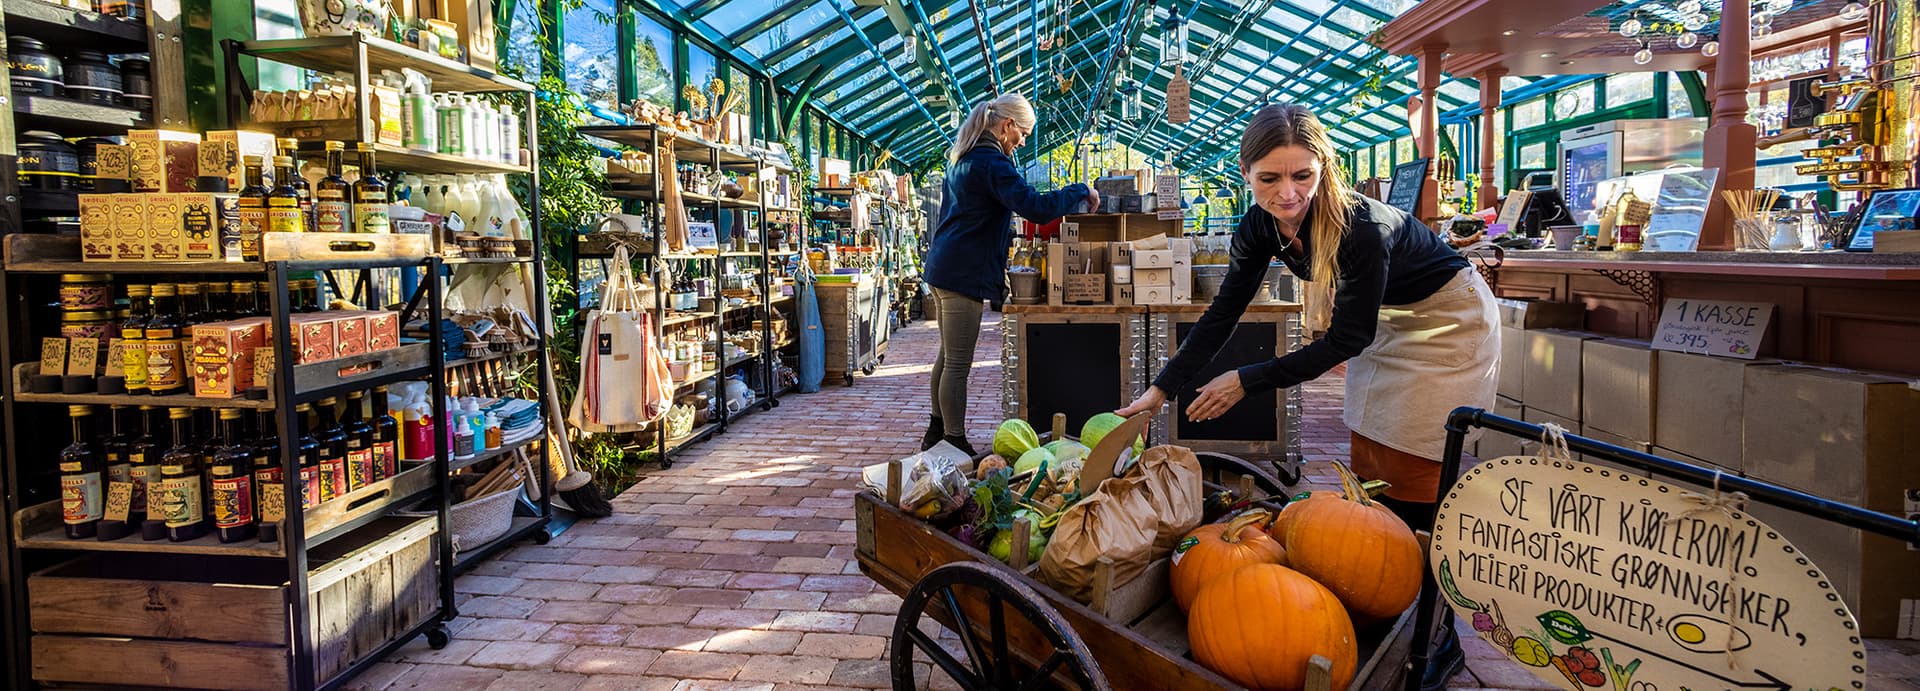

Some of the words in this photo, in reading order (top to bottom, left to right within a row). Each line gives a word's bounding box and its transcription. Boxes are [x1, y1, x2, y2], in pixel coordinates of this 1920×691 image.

[1677, 301, 1688, 322] 1
[1694, 304, 1759, 327] KASSE
[1459, 512, 1605, 578] FANTASTISKE
[1499, 477, 1534, 522] SE
[1549, 484, 1606, 538] VÅRT
[1618, 499, 1760, 577] KJØLEROM!
[1458, 552, 1527, 595] MEIERI
[1533, 573, 1654, 636] PRODUKTER
[1551, 620, 1579, 637] Debio
